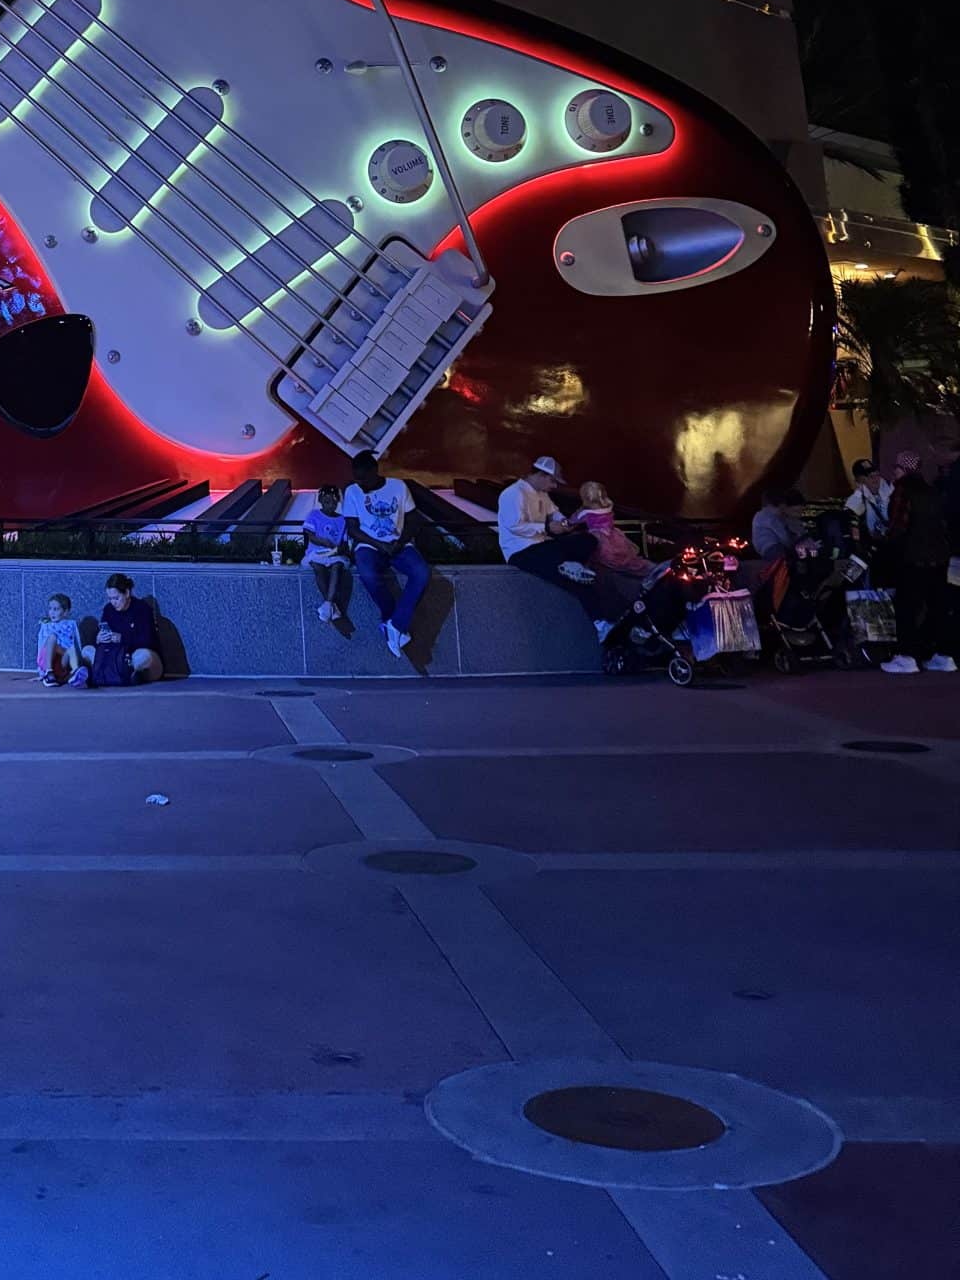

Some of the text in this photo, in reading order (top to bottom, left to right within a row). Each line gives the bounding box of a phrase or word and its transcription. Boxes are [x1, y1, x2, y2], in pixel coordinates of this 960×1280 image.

[606, 104, 617, 125] TONE
[500, 116, 510, 135] TONE
[391, 156, 425, 176] VOLUME
